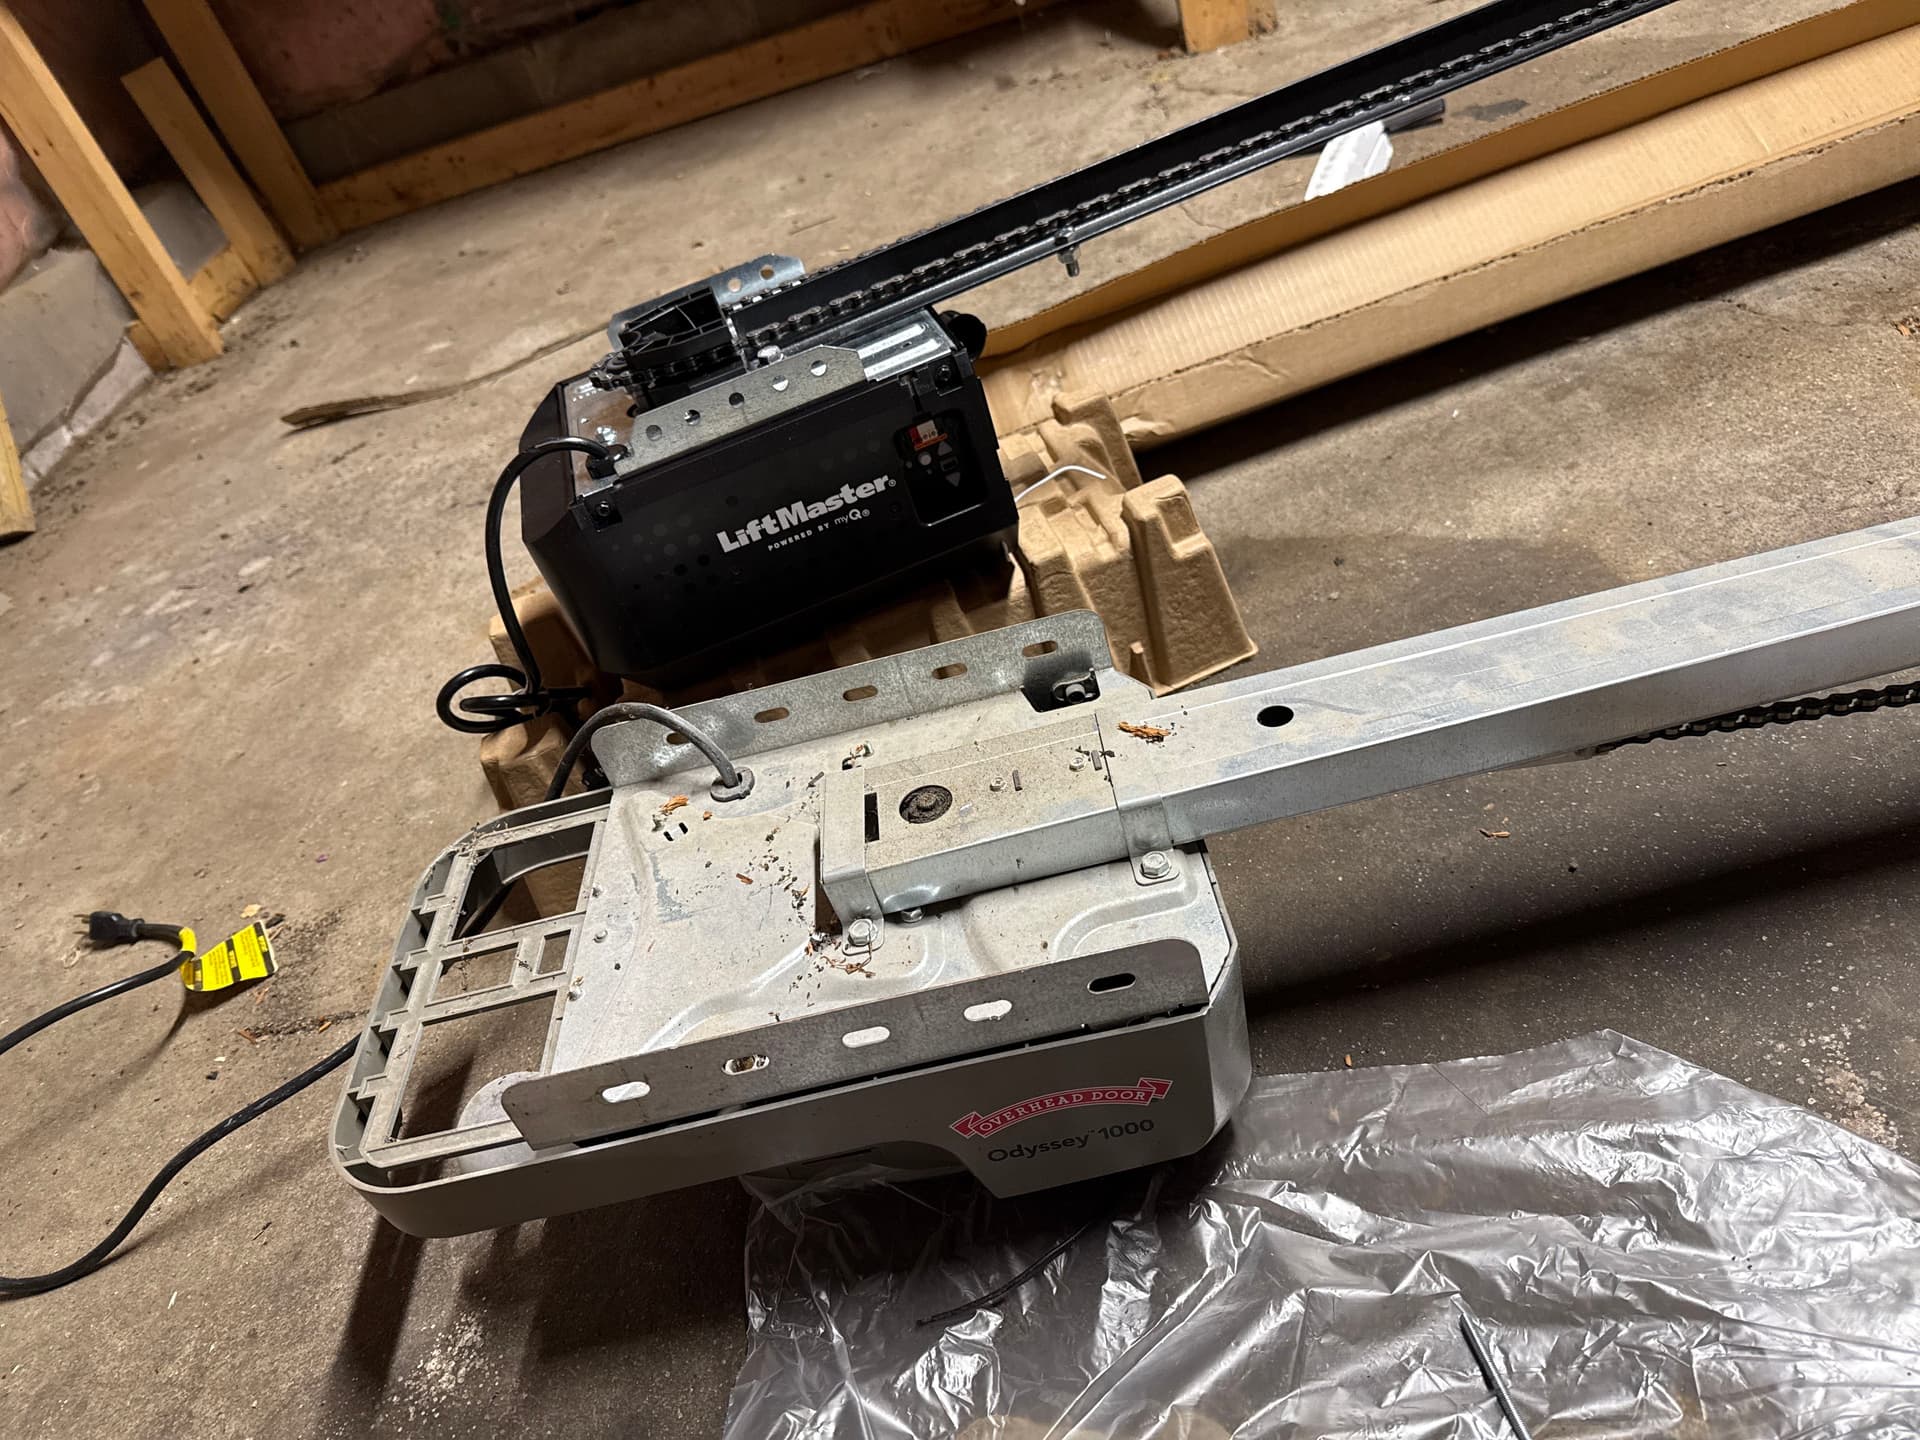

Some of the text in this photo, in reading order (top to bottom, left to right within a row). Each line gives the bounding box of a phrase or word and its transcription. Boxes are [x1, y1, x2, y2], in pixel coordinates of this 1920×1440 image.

[767, 529, 813, 551] POWERED
[817, 522, 831, 533] BY
[979, 1090, 1146, 1132] OVERHEAD DOOR
[1098, 1119, 1155, 1140] 1000
